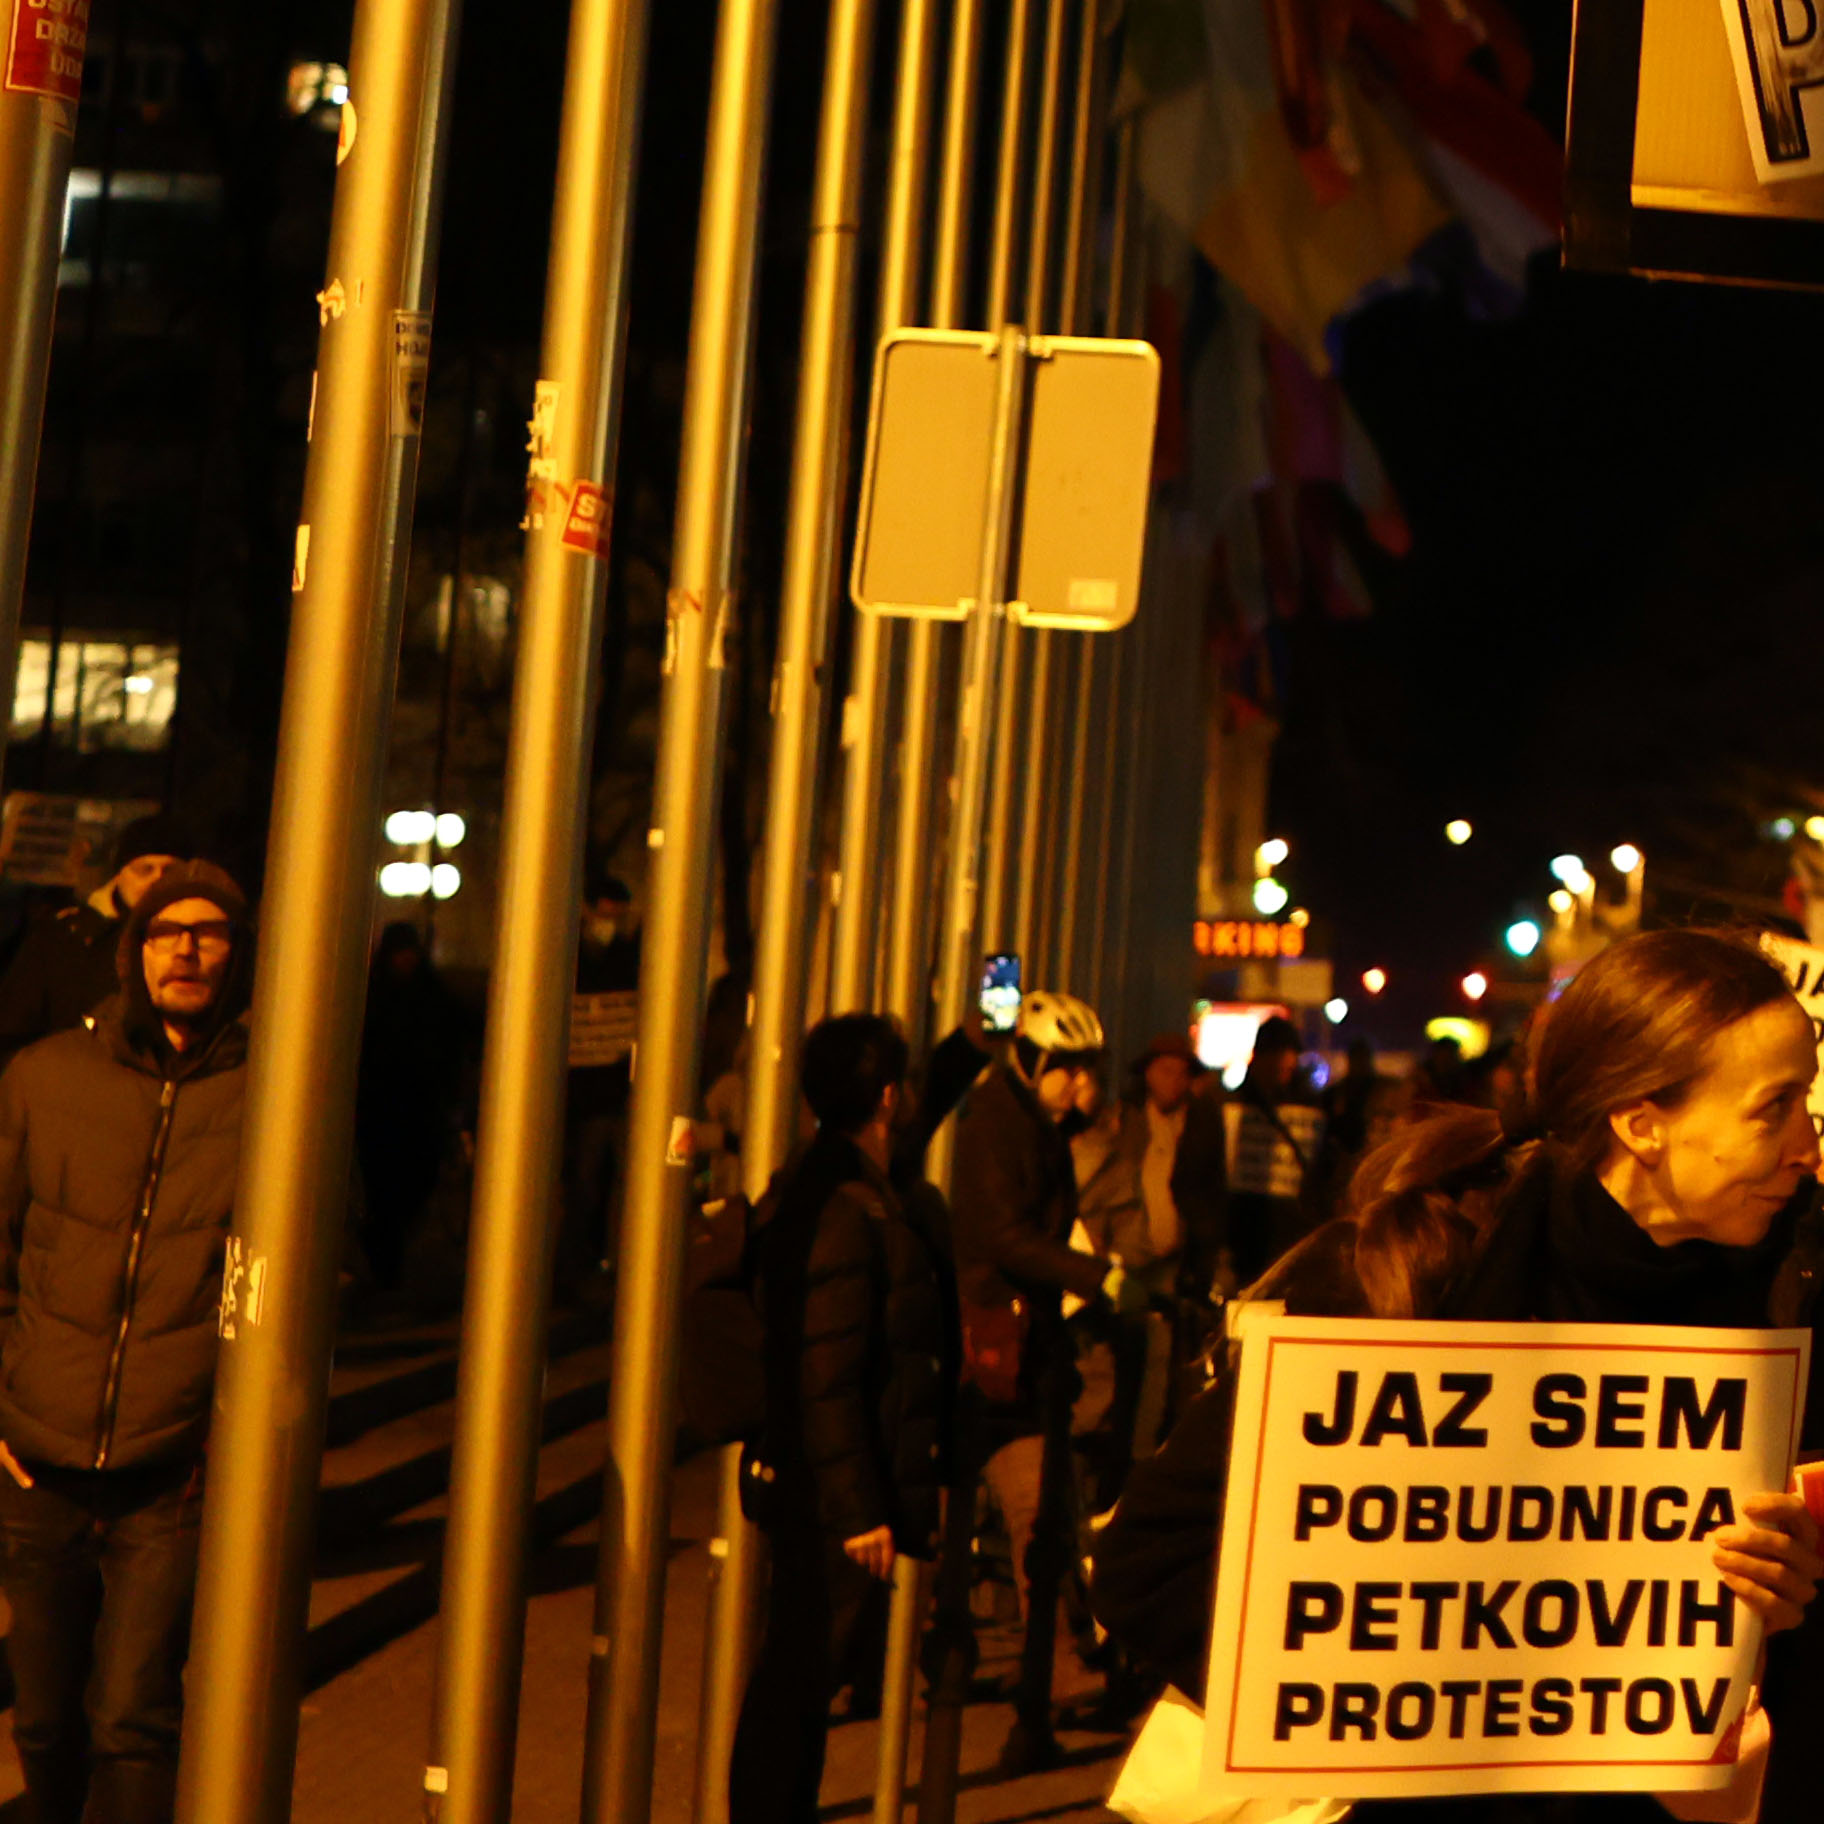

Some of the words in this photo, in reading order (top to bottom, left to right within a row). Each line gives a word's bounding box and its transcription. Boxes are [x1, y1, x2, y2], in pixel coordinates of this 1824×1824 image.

[1303, 1371, 1493, 1447] JAZ
[1530, 1373, 1748, 1451] SEM
[1294, 1484, 1736, 1542] POBUDNICA
[1283, 1579, 1736, 1651] PETKOVIH
[1274, 1677, 1732, 1741] PROTESTOV
